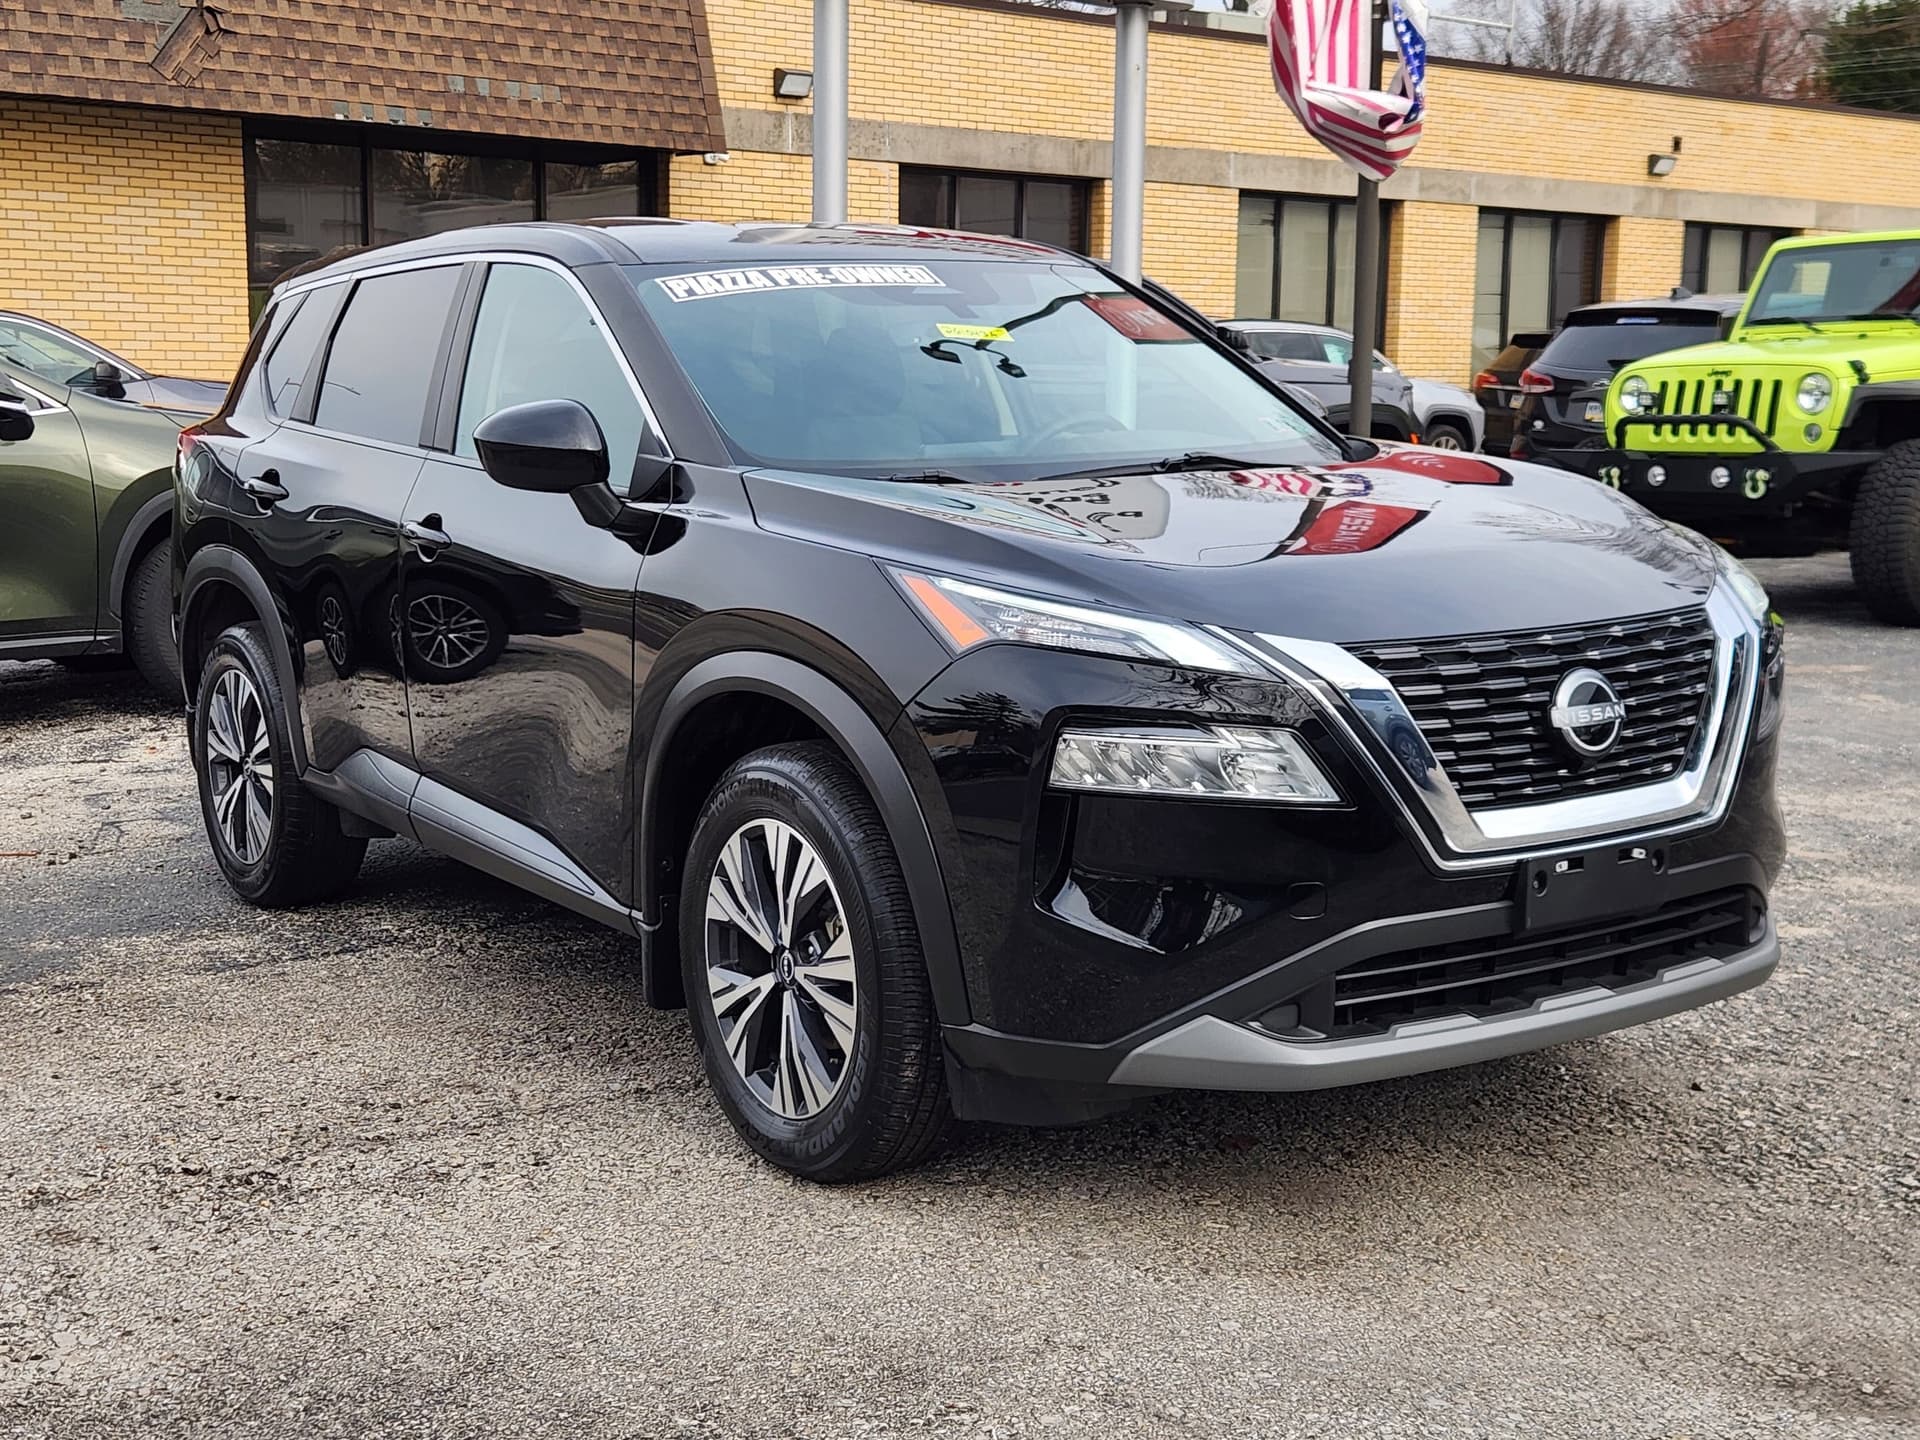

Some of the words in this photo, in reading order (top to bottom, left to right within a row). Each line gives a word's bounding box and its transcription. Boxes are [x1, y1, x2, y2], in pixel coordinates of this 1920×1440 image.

[664, 269, 770, 299] PIAZZA
[772, 265, 936, 286] PRE-OWNED
[1706, 368, 1733, 378] Jeep
[1331, 507, 1377, 543] NISSAN
[1555, 702, 1626, 725] NISSAN
